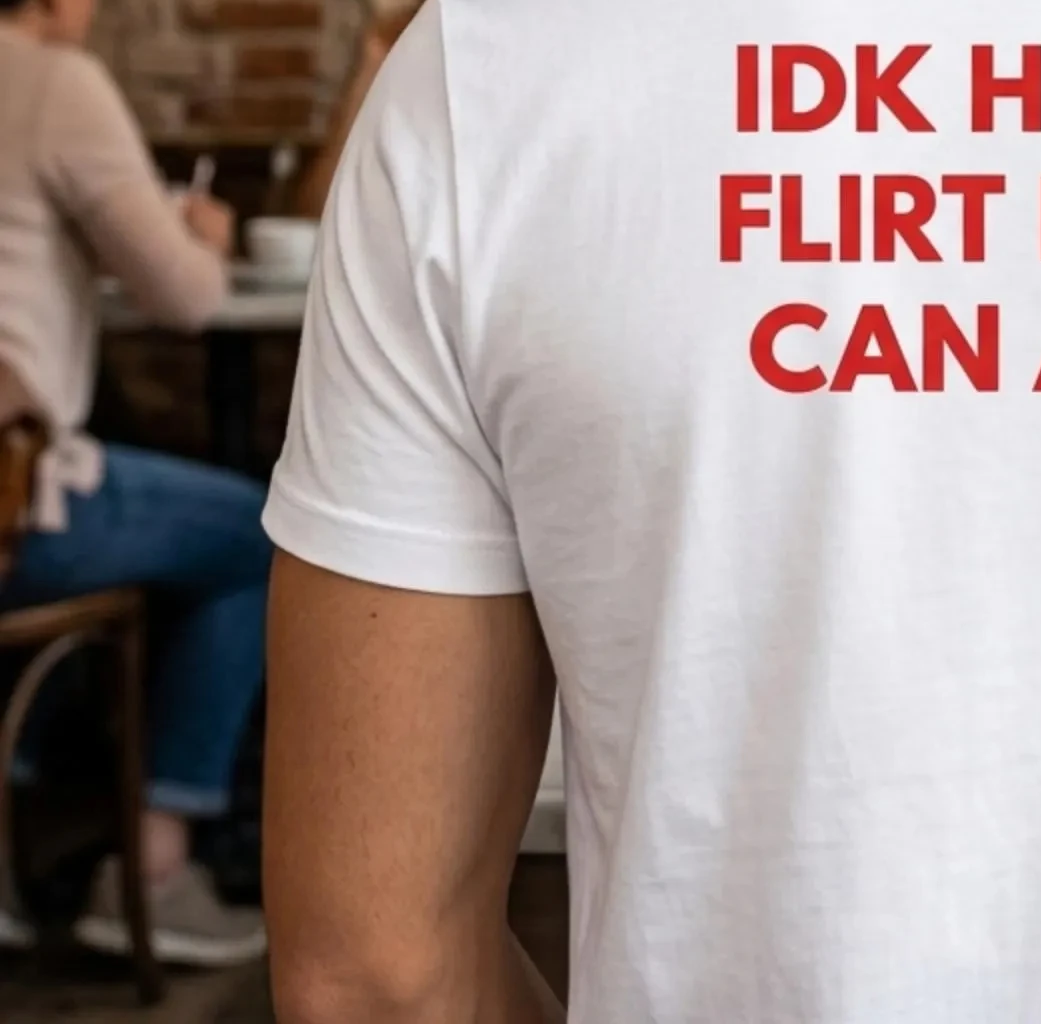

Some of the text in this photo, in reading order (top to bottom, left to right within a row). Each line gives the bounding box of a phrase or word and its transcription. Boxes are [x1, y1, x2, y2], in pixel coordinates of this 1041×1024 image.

[736, 44, 935, 133] IDK
[719, 174, 1006, 263] FLIRT
[749, 303, 1000, 393] CAN
